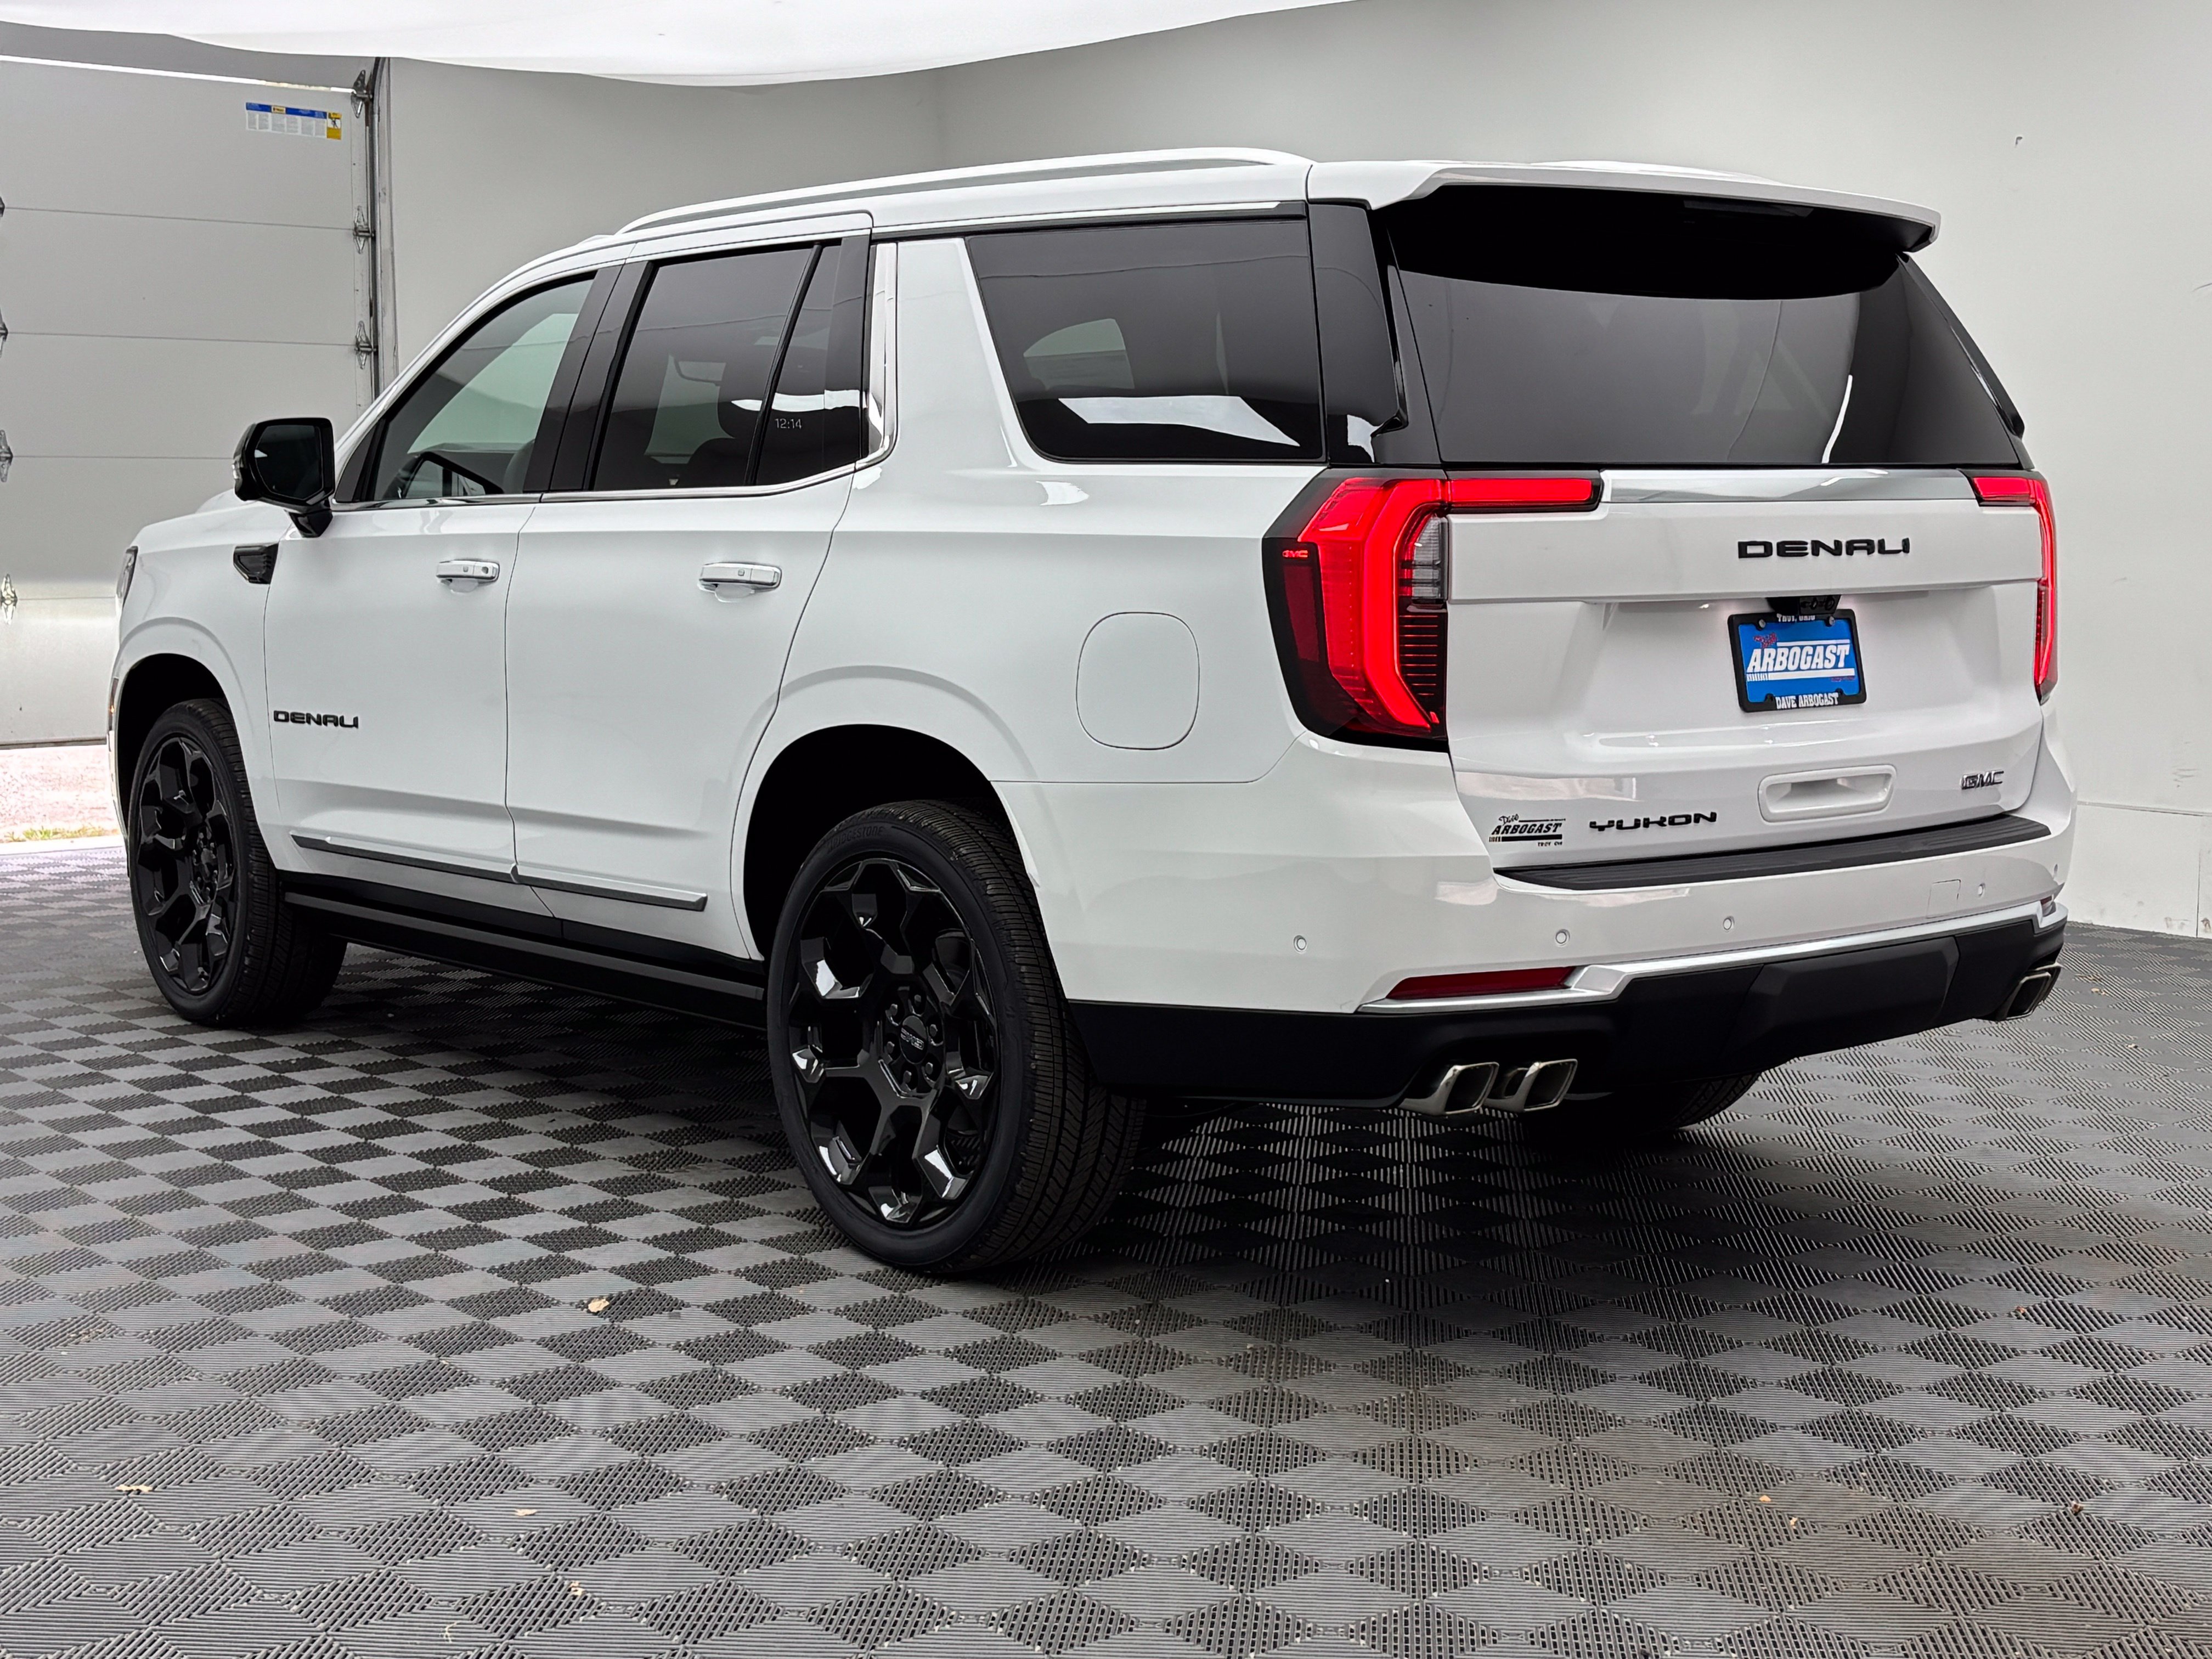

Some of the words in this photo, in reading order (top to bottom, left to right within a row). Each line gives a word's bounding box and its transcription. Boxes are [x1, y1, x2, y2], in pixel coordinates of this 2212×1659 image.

[774, 418, 802, 429] 12:14
[1282, 550, 1308, 558] GMC
[1737, 538, 1910, 558] DENALI
[1747, 644, 1850, 673] ARBOGAST
[1775, 695, 1798, 709] DAVE
[1798, 692, 1839, 708] ARBOGAST
[273, 710, 359, 729] DENALI
[1961, 770, 2005, 790] GMC
[1491, 822, 1562, 835] ARBOGAST
[1589, 812, 1717, 832] YUKON
